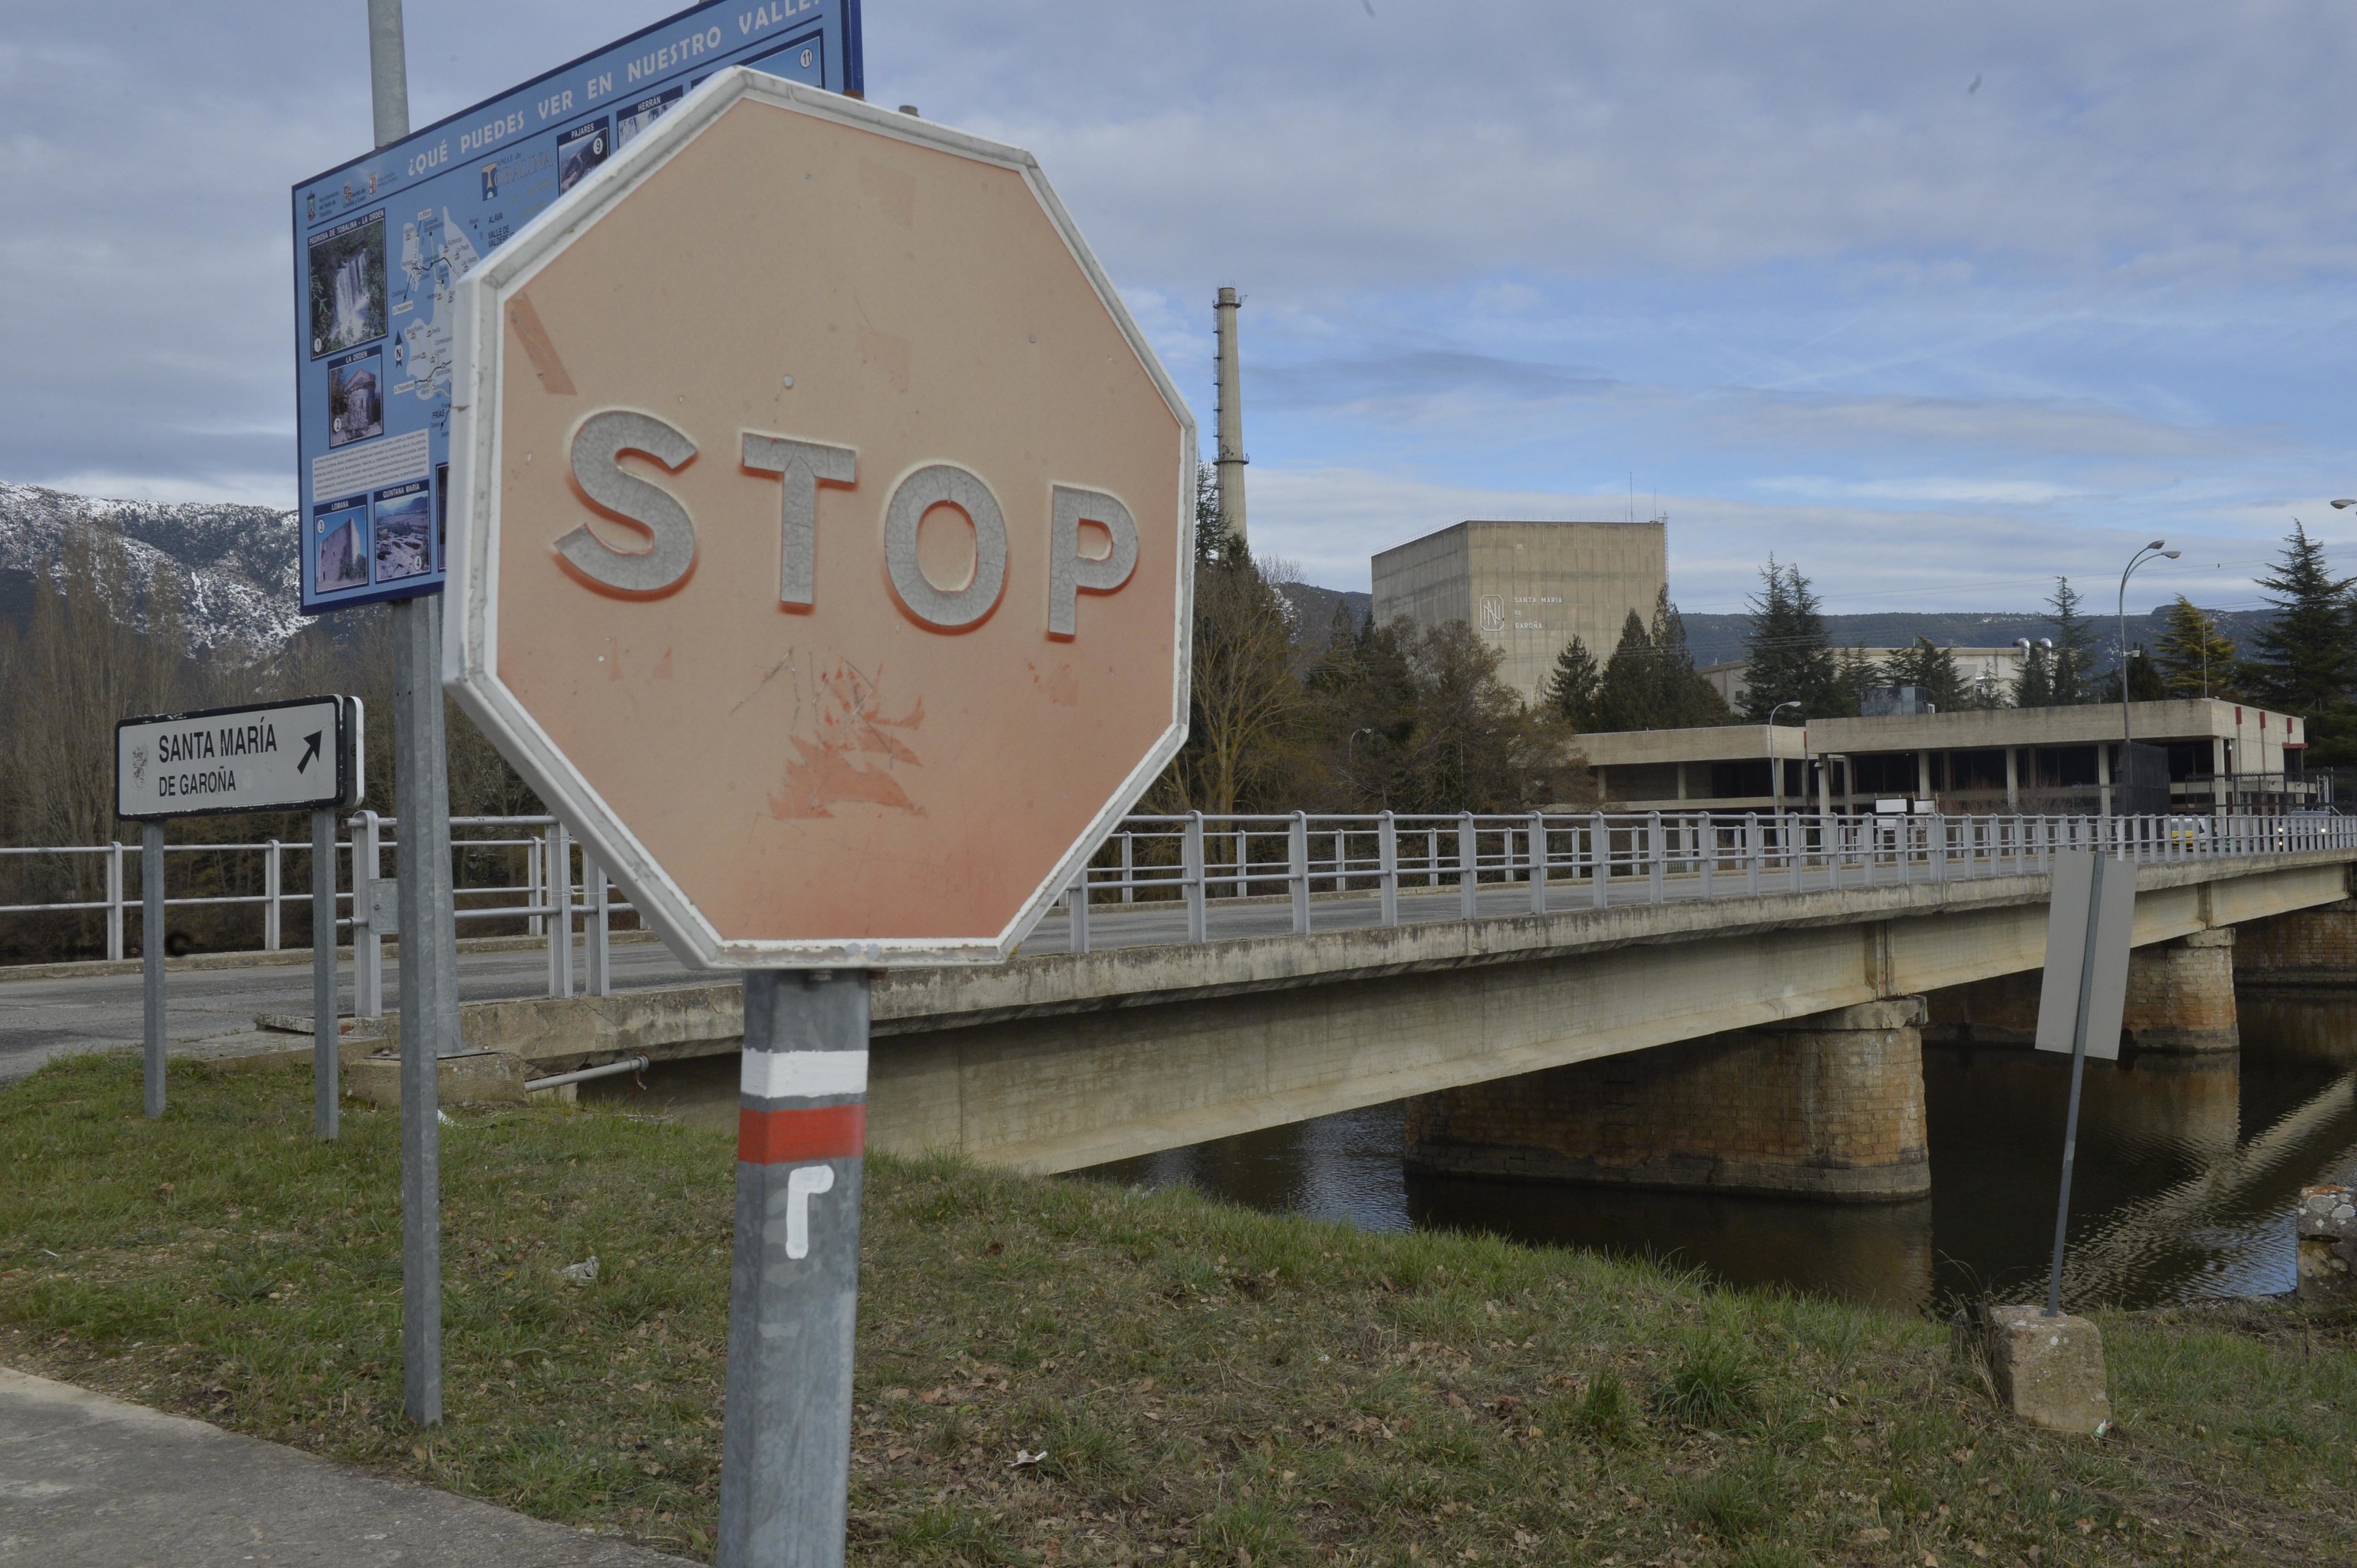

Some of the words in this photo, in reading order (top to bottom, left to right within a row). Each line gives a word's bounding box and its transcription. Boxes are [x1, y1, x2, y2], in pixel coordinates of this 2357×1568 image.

[408, 140, 448, 176] ¿QUÉ
[461, 110, 525, 153] PUEDES
[538, 90, 572, 120] VER
[588, 72, 612, 100] EN
[628, 26, 722, 83] NUESTRO
[571, 123, 595, 139] PAJARES
[308, 232, 328, 245] PEDROSA
[329, 229, 335, 237] DE
[337, 220, 358, 234] TOBALINA
[369, 209, 384, 221] ORDEN
[353, 351, 368, 361] ORDEN
[396, 348, 401, 359] N
[383, 486, 404, 499] QUINTANA
[331, 500, 349, 511] LOMANA
[552, 410, 1139, 637] STOP
[159, 730, 215, 763] SANTA
[220, 716, 278, 756] MARÍA
[159, 775, 176, 797] DE
[180, 765, 236, 796] GAROÑA
